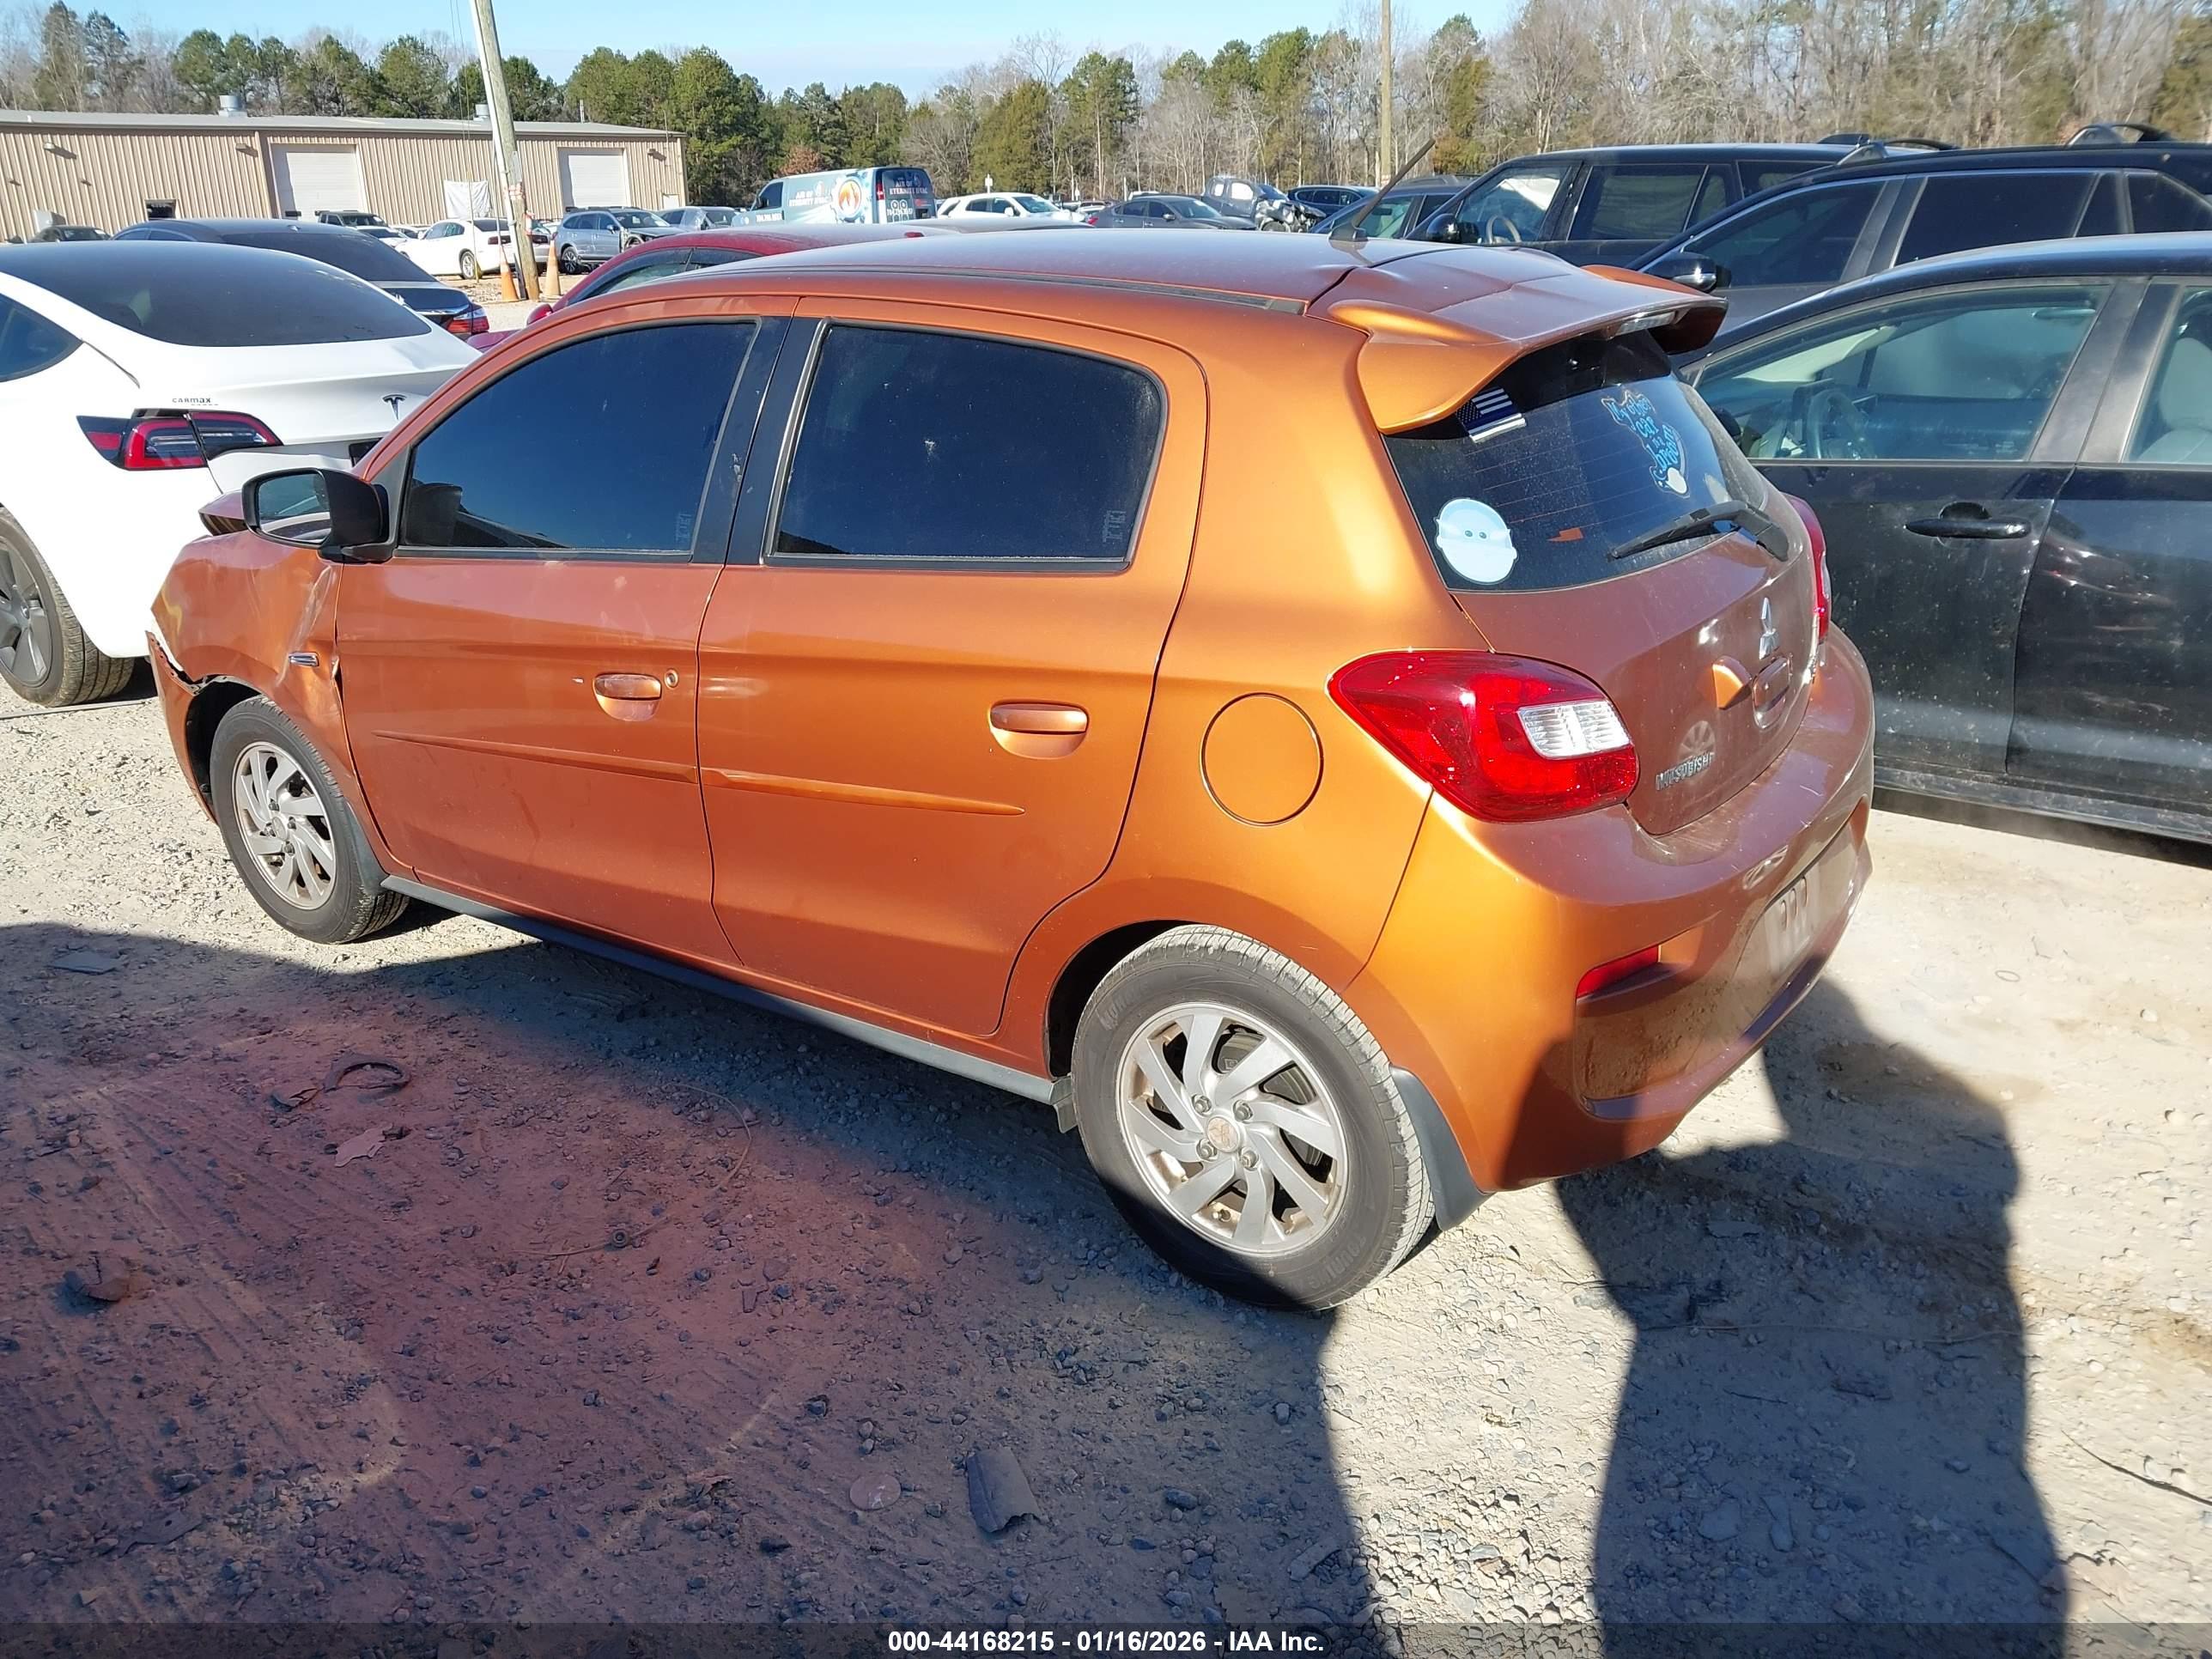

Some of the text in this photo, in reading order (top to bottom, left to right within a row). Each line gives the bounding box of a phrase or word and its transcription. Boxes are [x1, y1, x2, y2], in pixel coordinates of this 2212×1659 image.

[1606, 400, 1637, 431] My
[1635, 416, 1659, 439] car
[1646, 424, 1679, 471] broom
